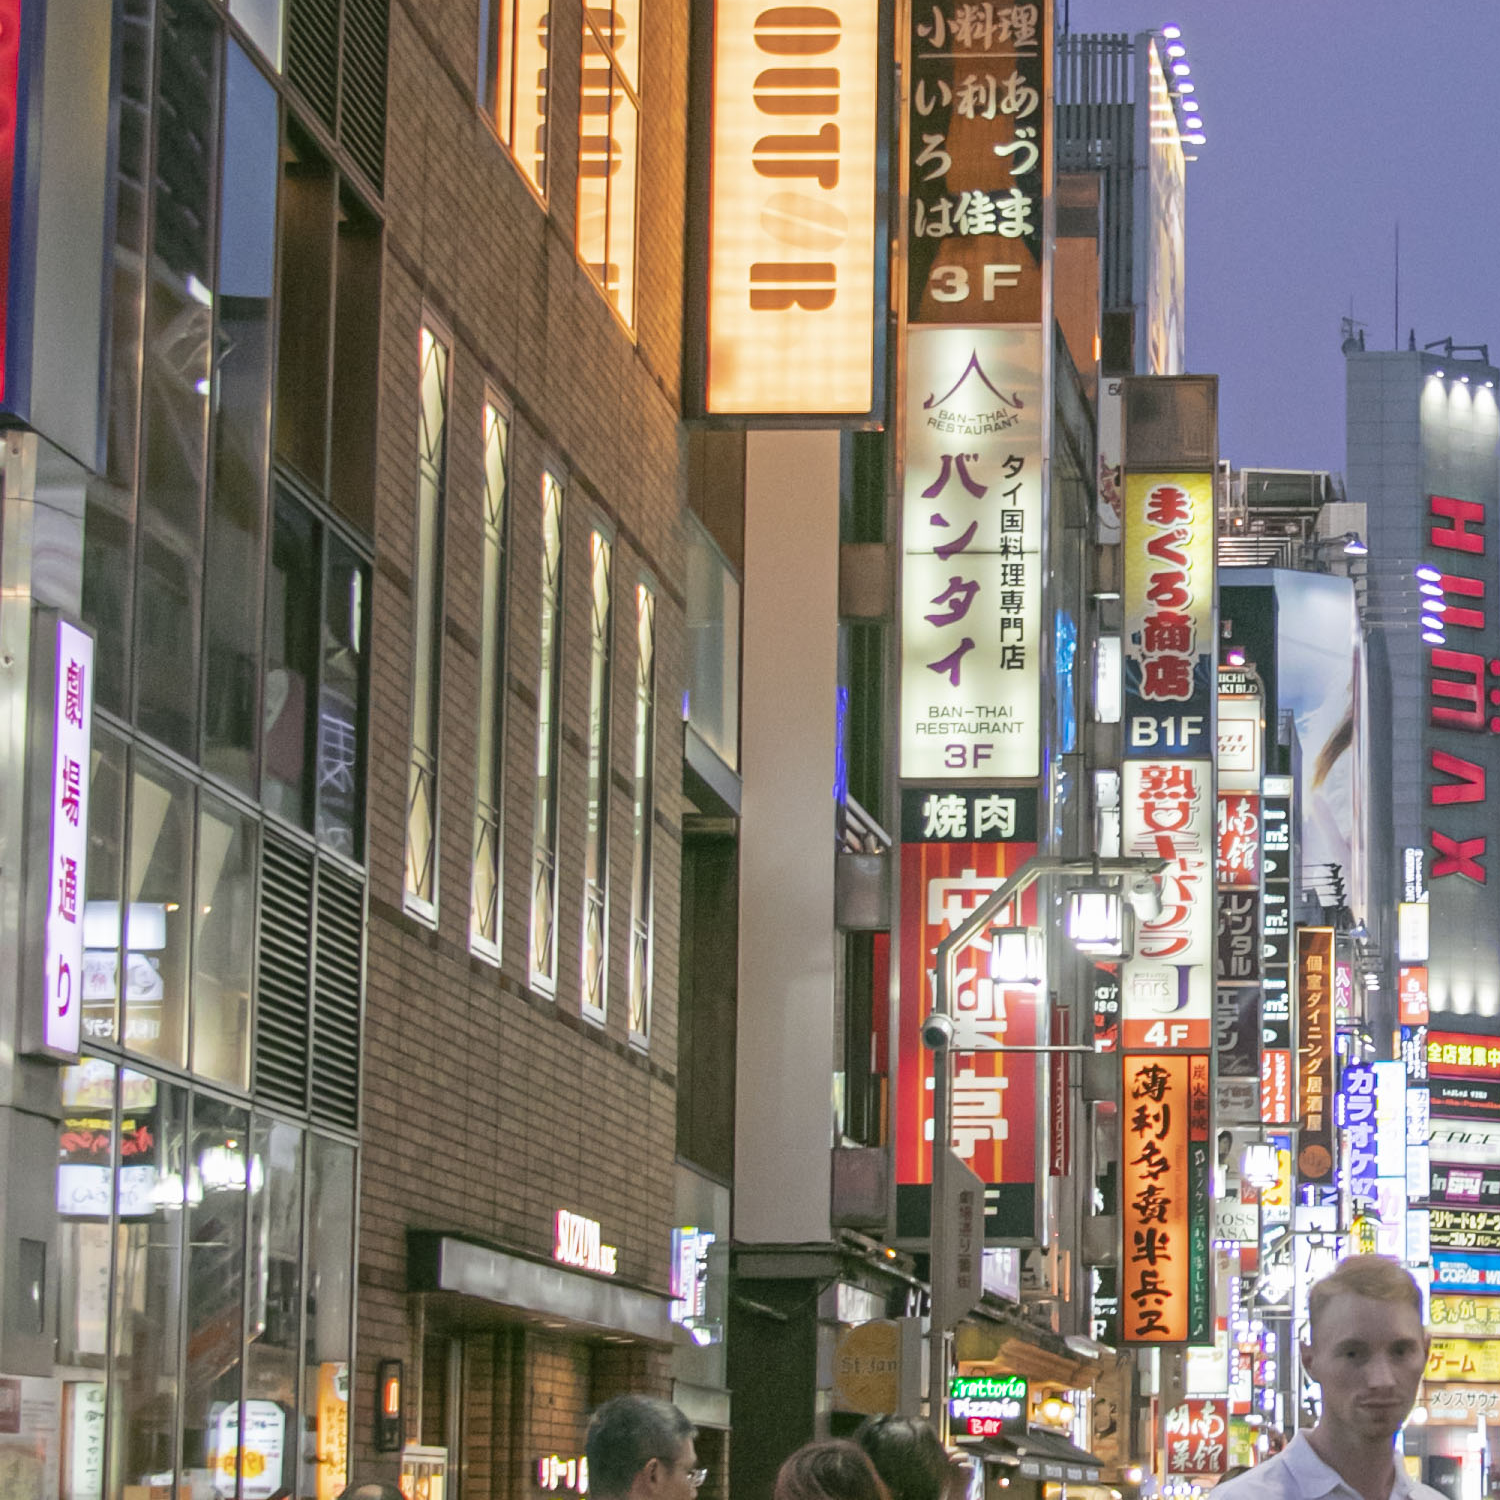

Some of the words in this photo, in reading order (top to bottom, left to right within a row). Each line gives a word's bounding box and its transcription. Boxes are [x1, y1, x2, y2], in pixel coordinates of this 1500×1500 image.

[917, 2, 1038, 49] 小料理
[914, 78, 952, 238] いろは
[929, 263, 1023, 302] 3F
[926, 413, 1021, 437] RESTAURANT
[938, 407, 1009, 425] BAN-THAI
[920, 451, 990, 688] バンタイ
[1000, 453, 1026, 671] タイ国料理専門店
[1145, 485, 1193, 698] まぐろ商店
[915, 721, 1024, 735] RESTAURANT
[928, 705, 1013, 722] BAN-THAI
[1131, 716, 1204, 747] B1F
[944, 743, 995, 769] 3F
[924, 793, 1017, 838] 焼肉
[58, 657, 86, 1020] 劇場通り
[1230, 895, 1252, 977] レンタル
[1144, 1020, 1189, 1047] 4F
[1306, 955, 1324, 1132] 個室ダイニング居酒屋
[1347, 1068, 1375, 1176] カラオケ
[1449, 1233, 1476, 1247] ゴルフ
[970, 1417, 1000, 1435] Bar
